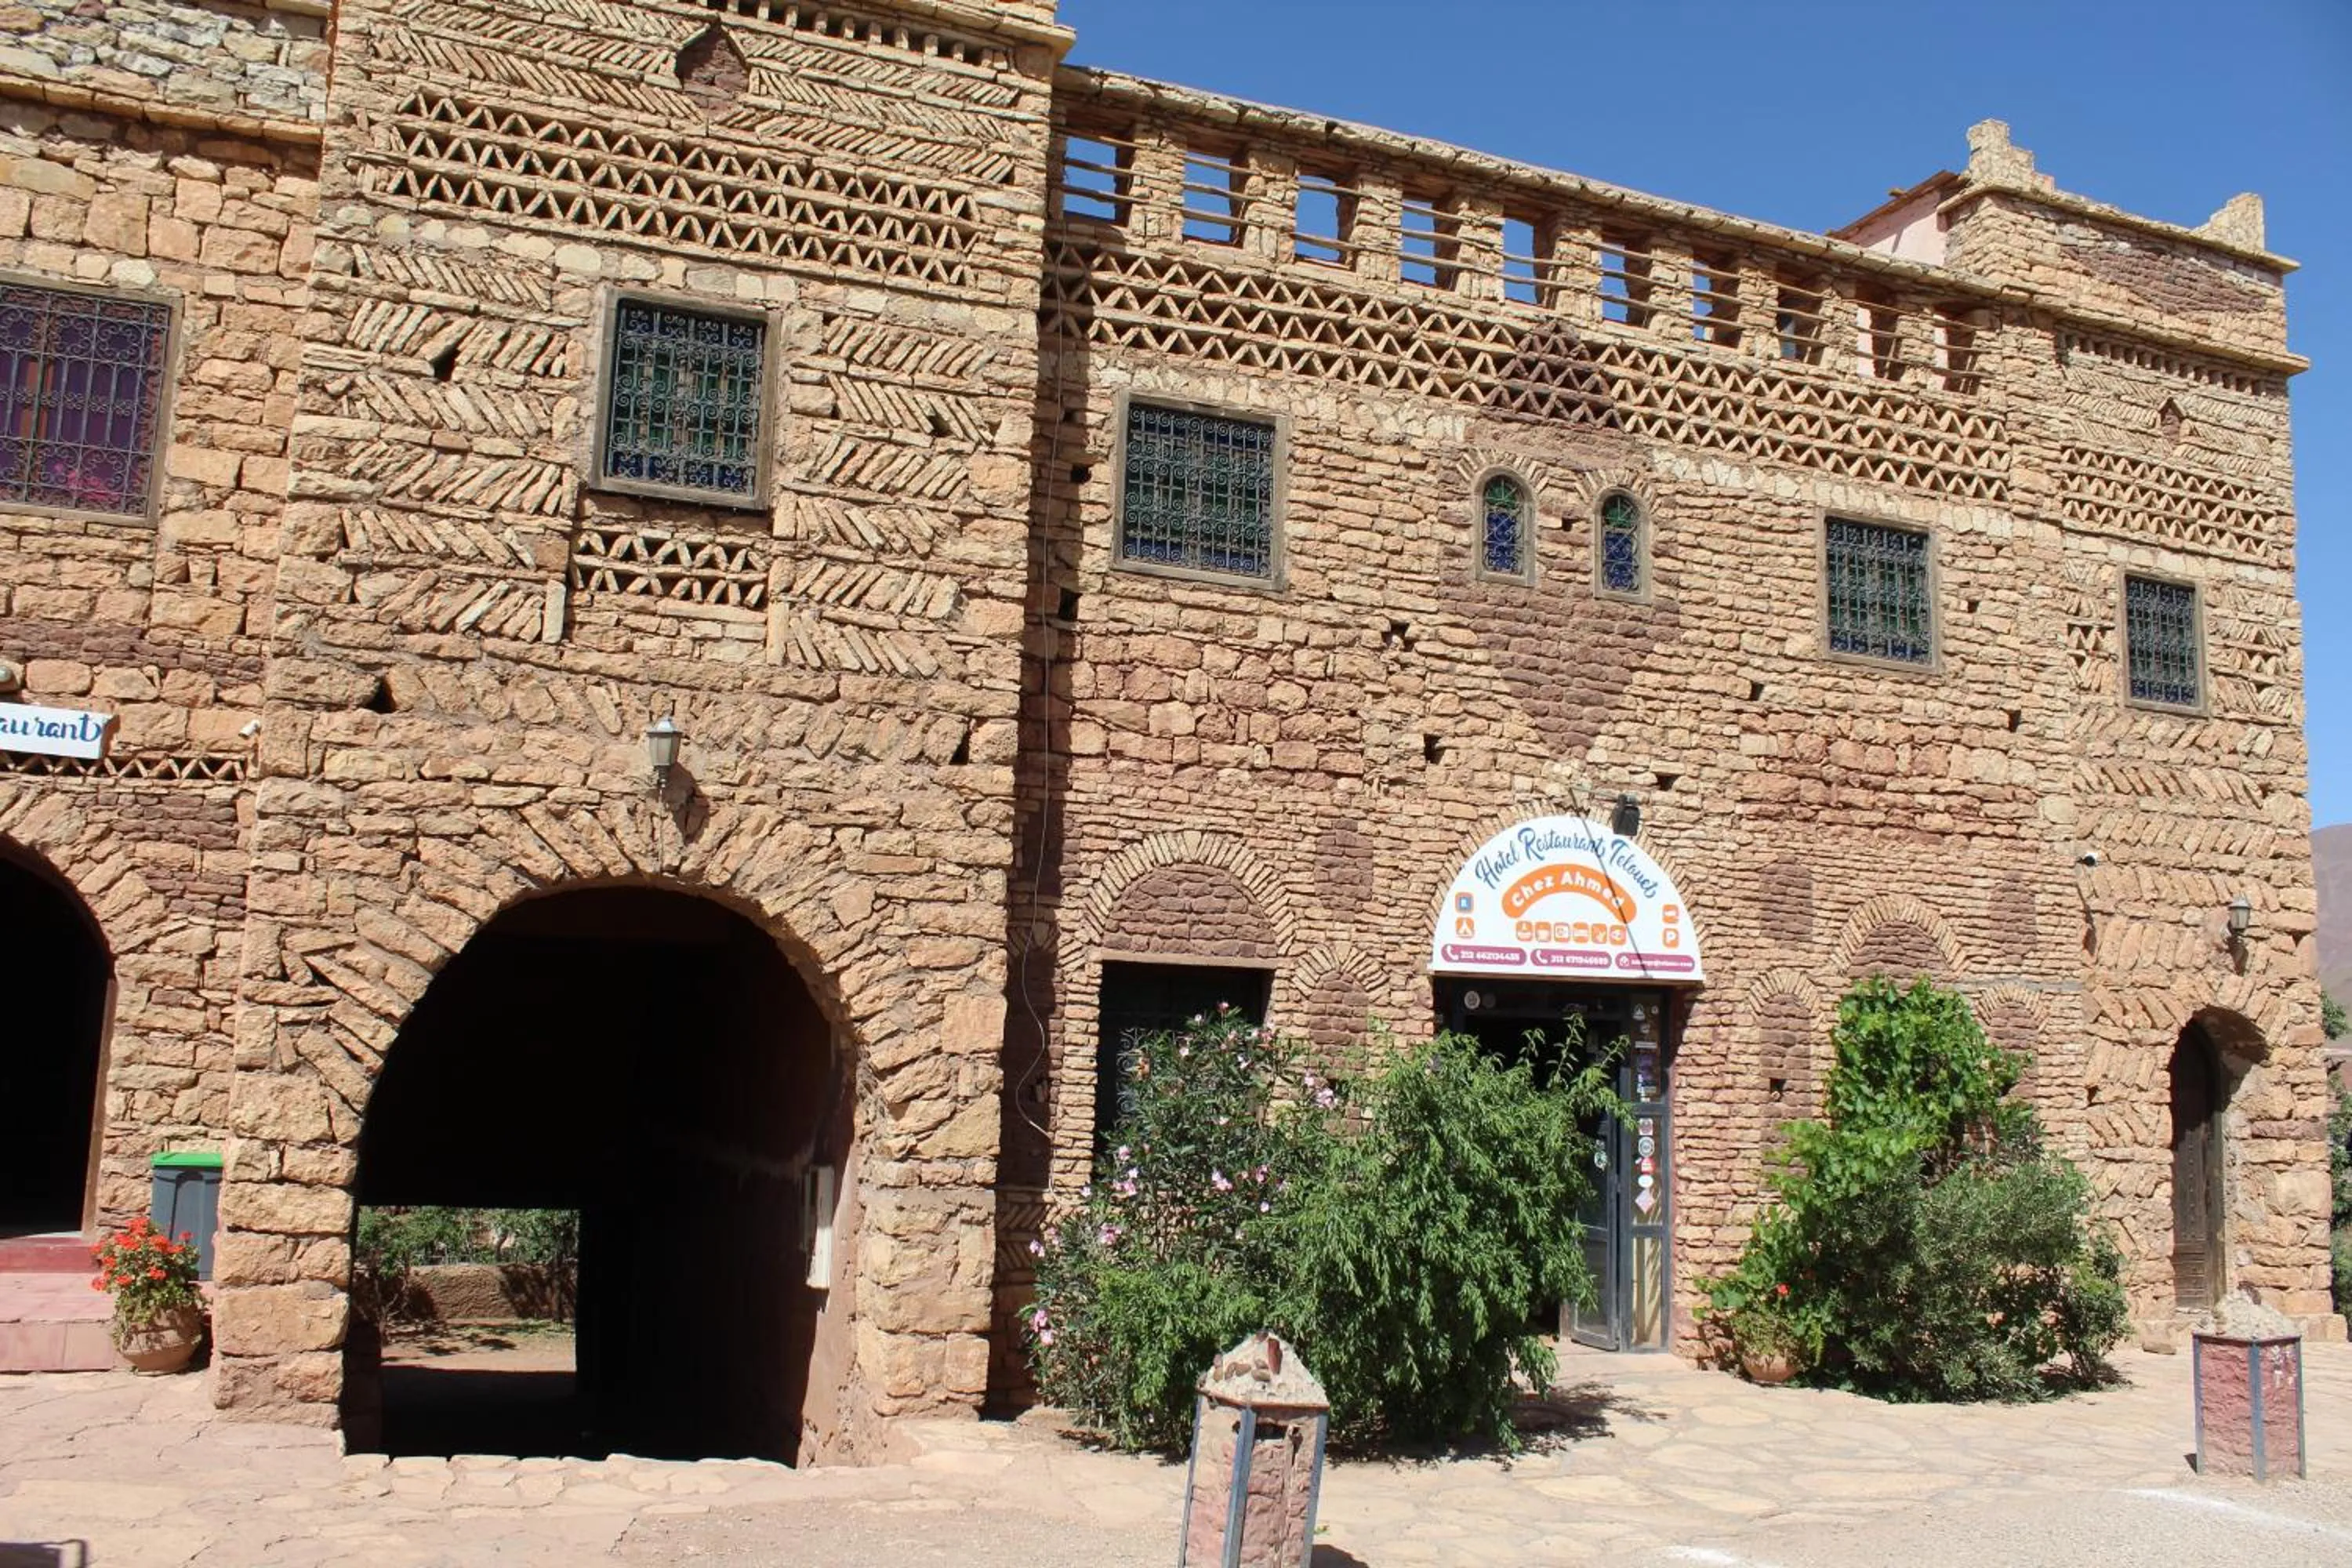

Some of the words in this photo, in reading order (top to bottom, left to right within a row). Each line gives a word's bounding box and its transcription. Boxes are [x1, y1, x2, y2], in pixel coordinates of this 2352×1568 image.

[1475, 837, 1519, 889] Hotel
[1518, 827, 1606, 861] Restaurant
[1610, 838, 1658, 898] Telouet
[1512, 876, 1554, 907] Chez
[1561, 871, 1624, 908] Ahmed
